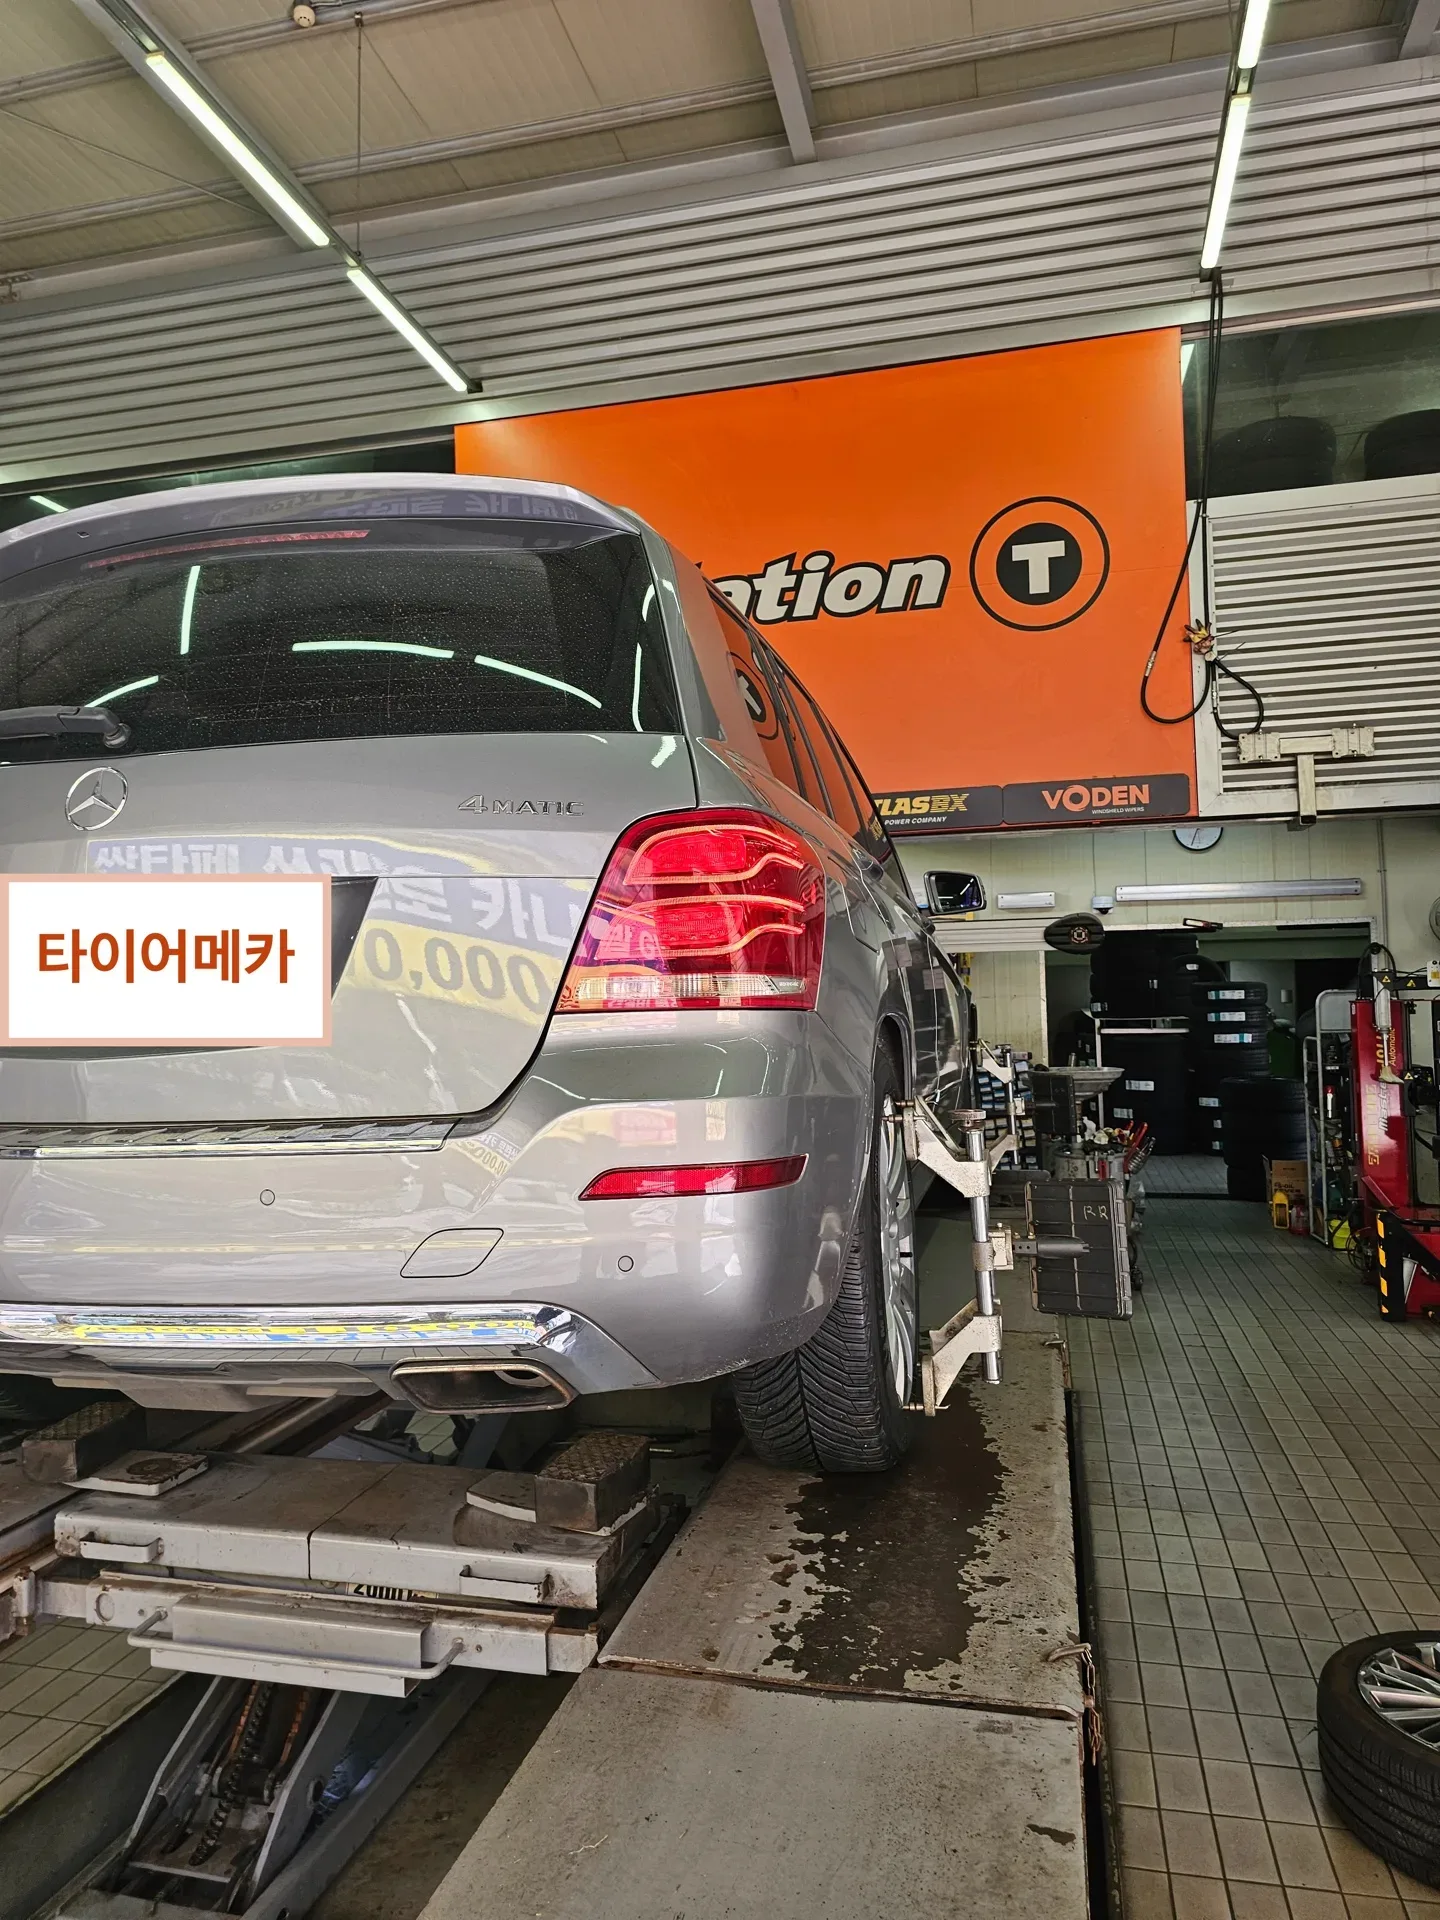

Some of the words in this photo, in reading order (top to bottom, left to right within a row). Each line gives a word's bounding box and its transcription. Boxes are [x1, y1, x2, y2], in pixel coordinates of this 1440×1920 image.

[1012, 540, 1066, 595] T
[458, 794, 585, 817] 4MATIC
[1041, 784, 1150, 812] VODEN
[884, 818, 911, 826] POWER
[911, 816, 947, 824] COMPANY
